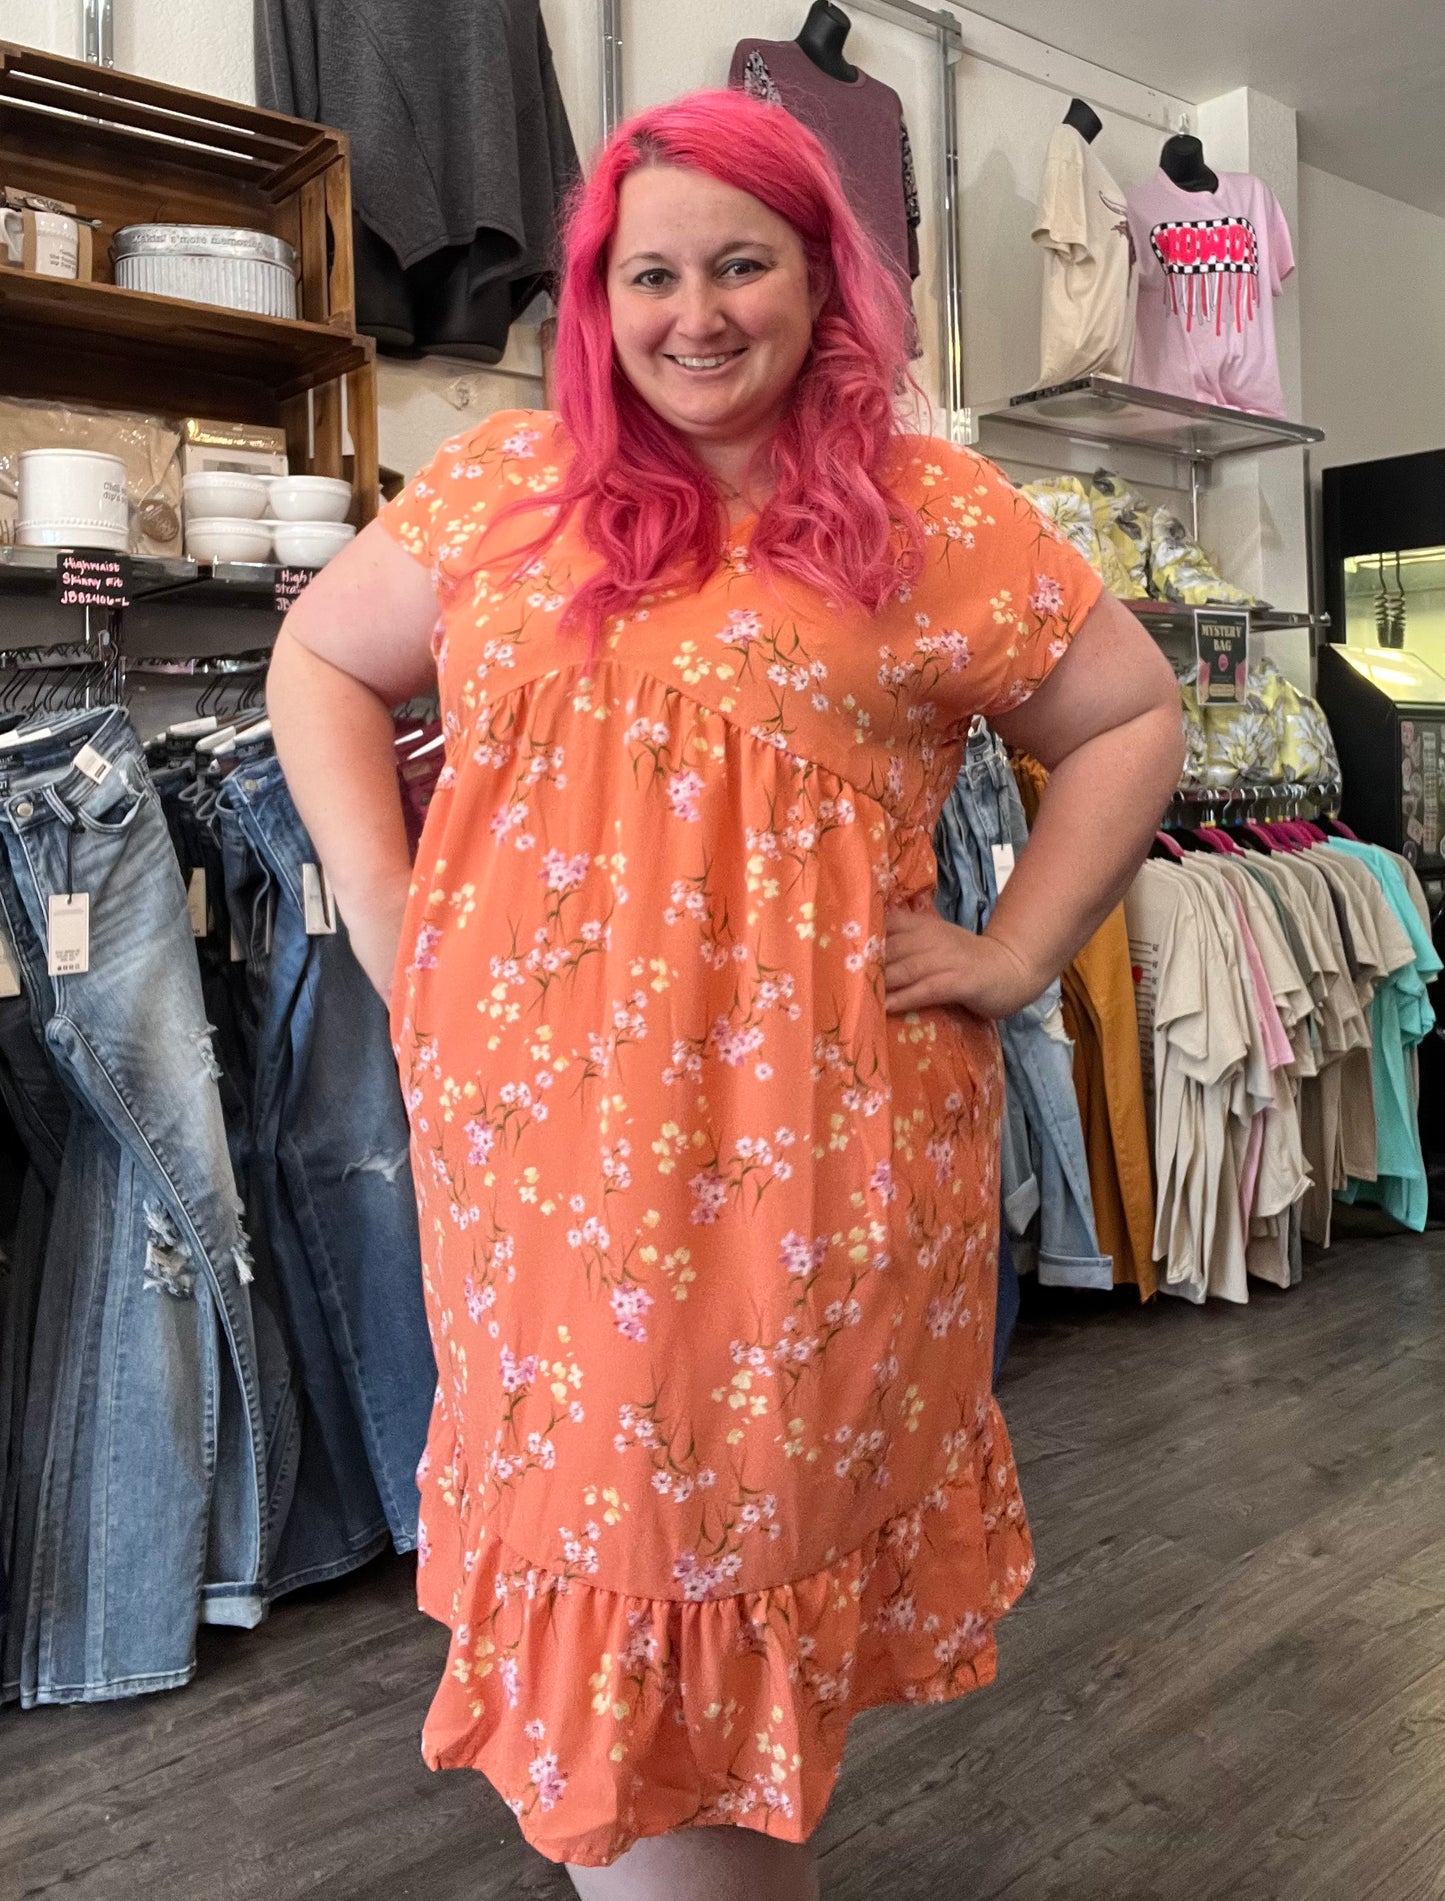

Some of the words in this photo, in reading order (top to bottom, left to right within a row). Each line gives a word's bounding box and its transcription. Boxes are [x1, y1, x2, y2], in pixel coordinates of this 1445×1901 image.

[62, 572, 101, 590] Skinny
[281, 569, 307, 588] High
[1201, 624, 1242, 638] MYSTERY
[1213, 638, 1232, 652] BAG
